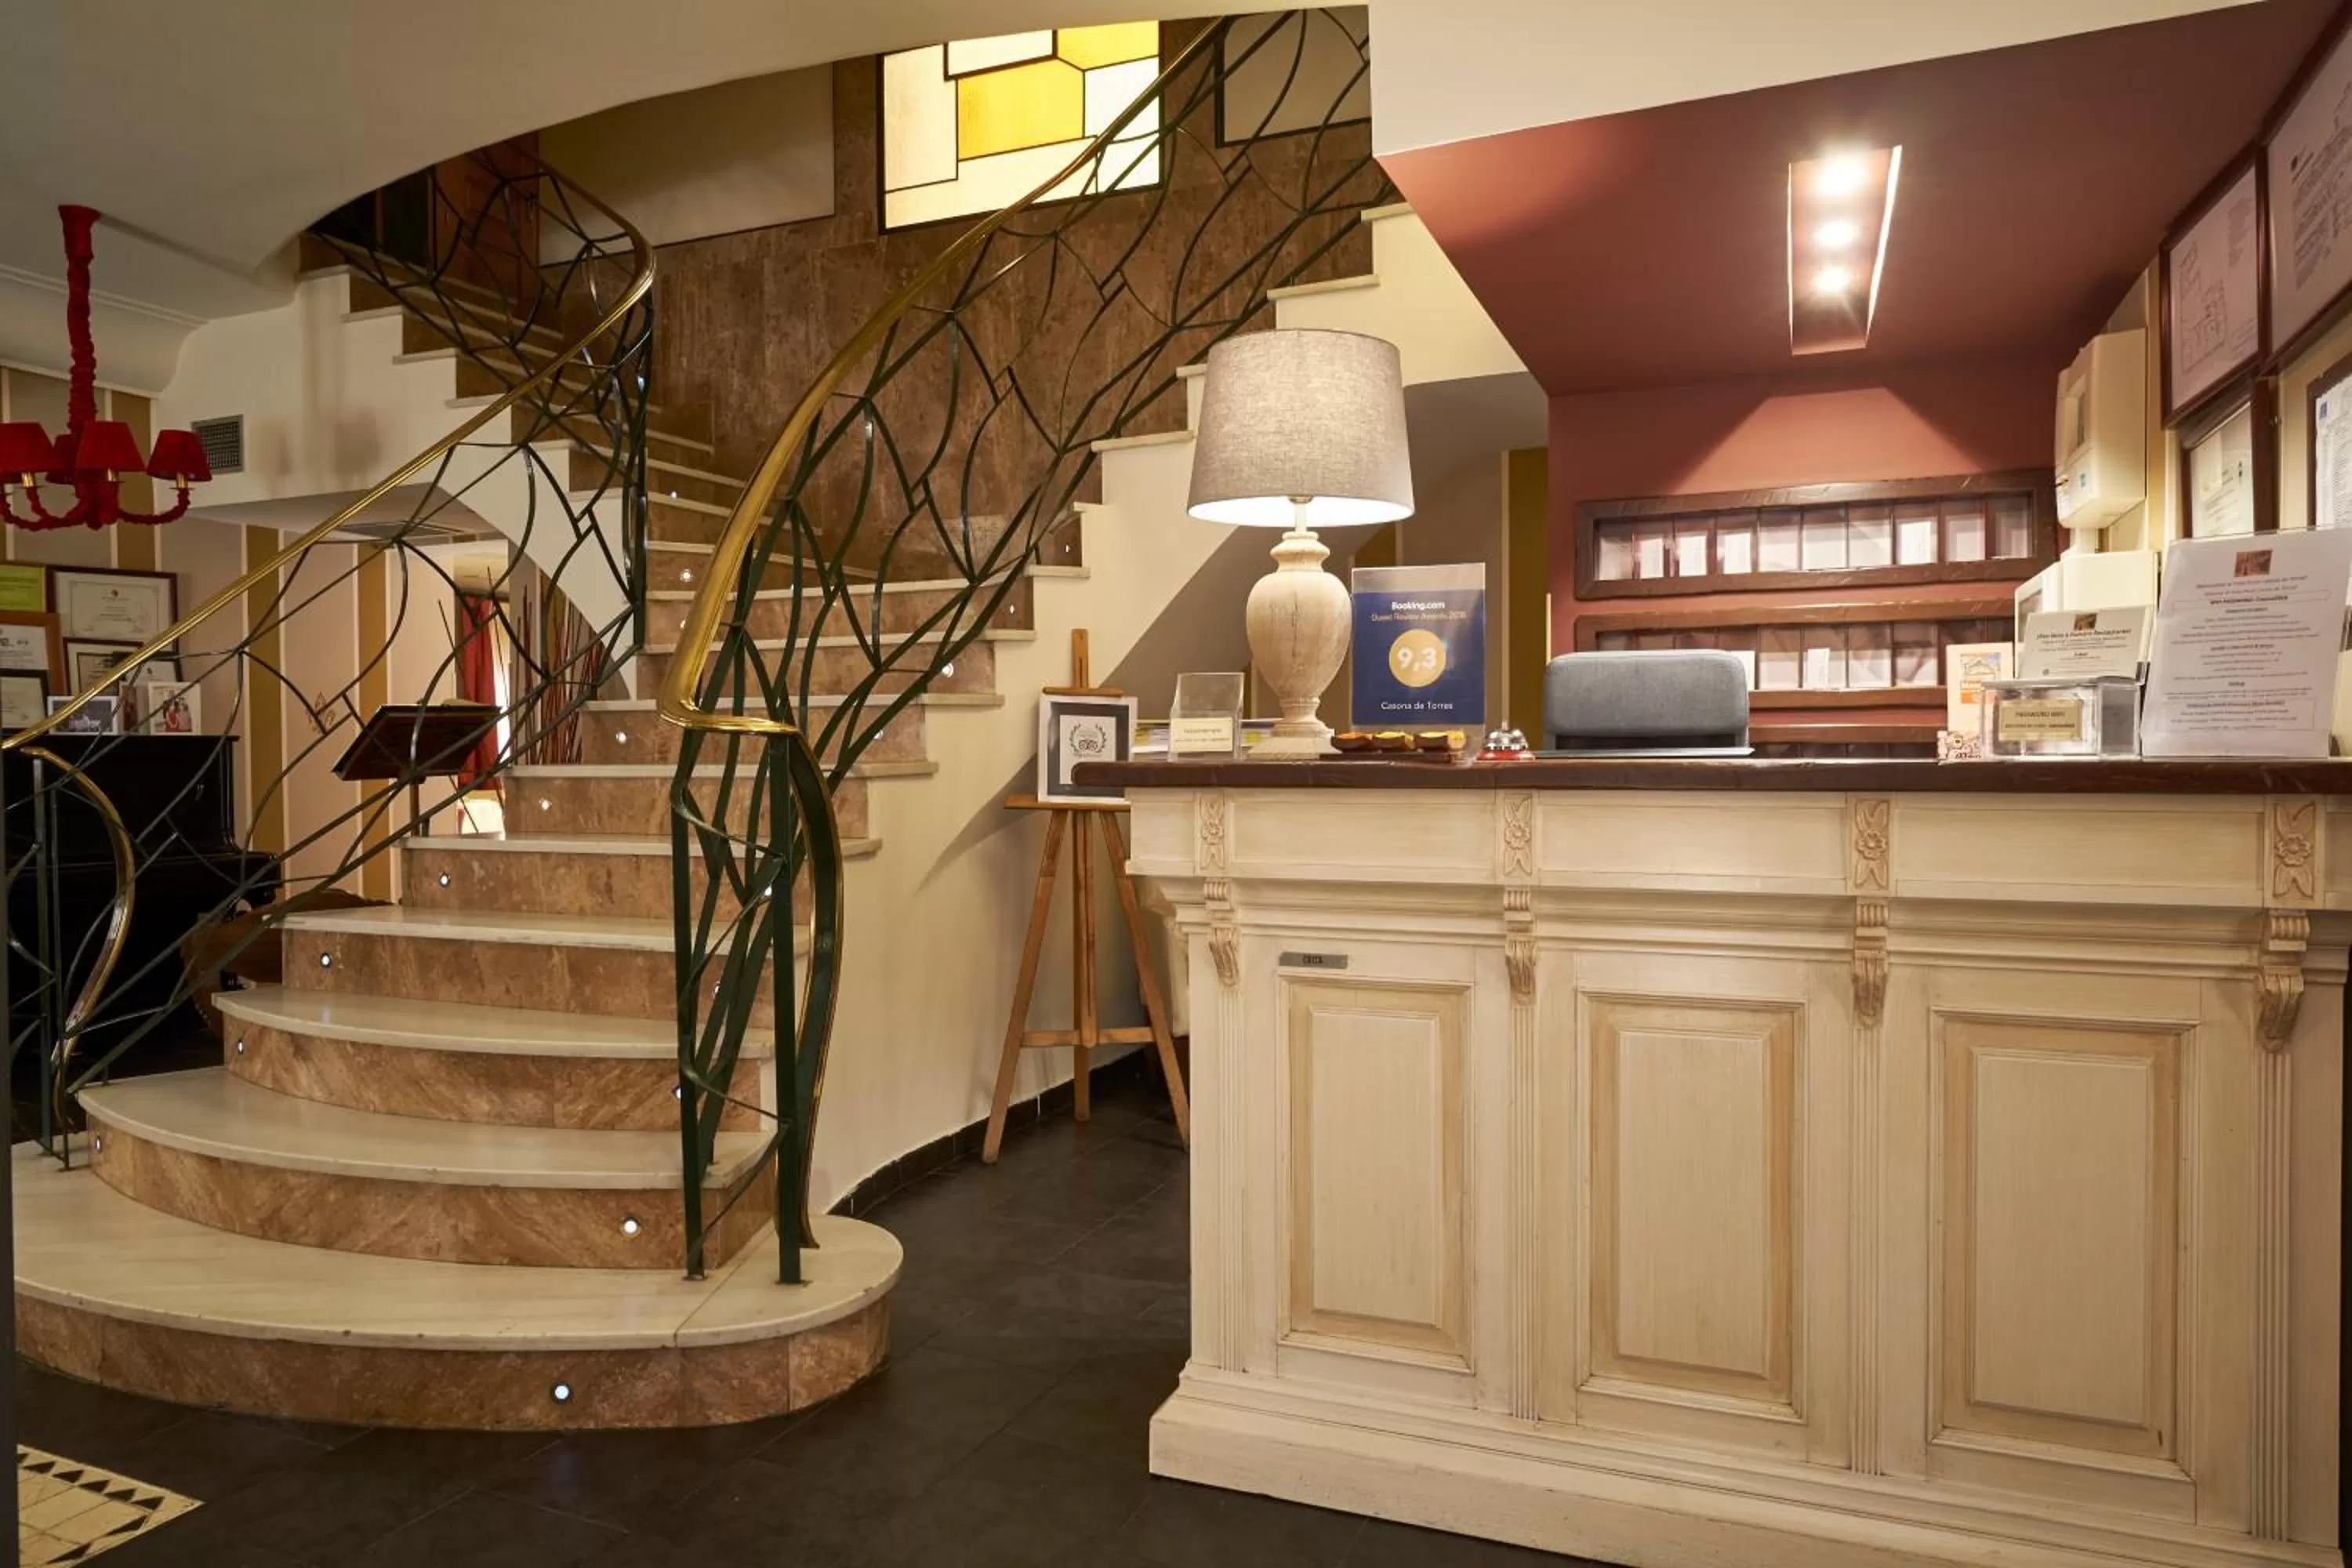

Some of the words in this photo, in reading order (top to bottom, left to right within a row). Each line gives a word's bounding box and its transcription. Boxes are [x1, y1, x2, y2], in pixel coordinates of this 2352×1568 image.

[1392, 601, 1445, 611] Booking.com
[1414, 701, 1425, 710] de
[1427, 701, 1454, 710] Torres
